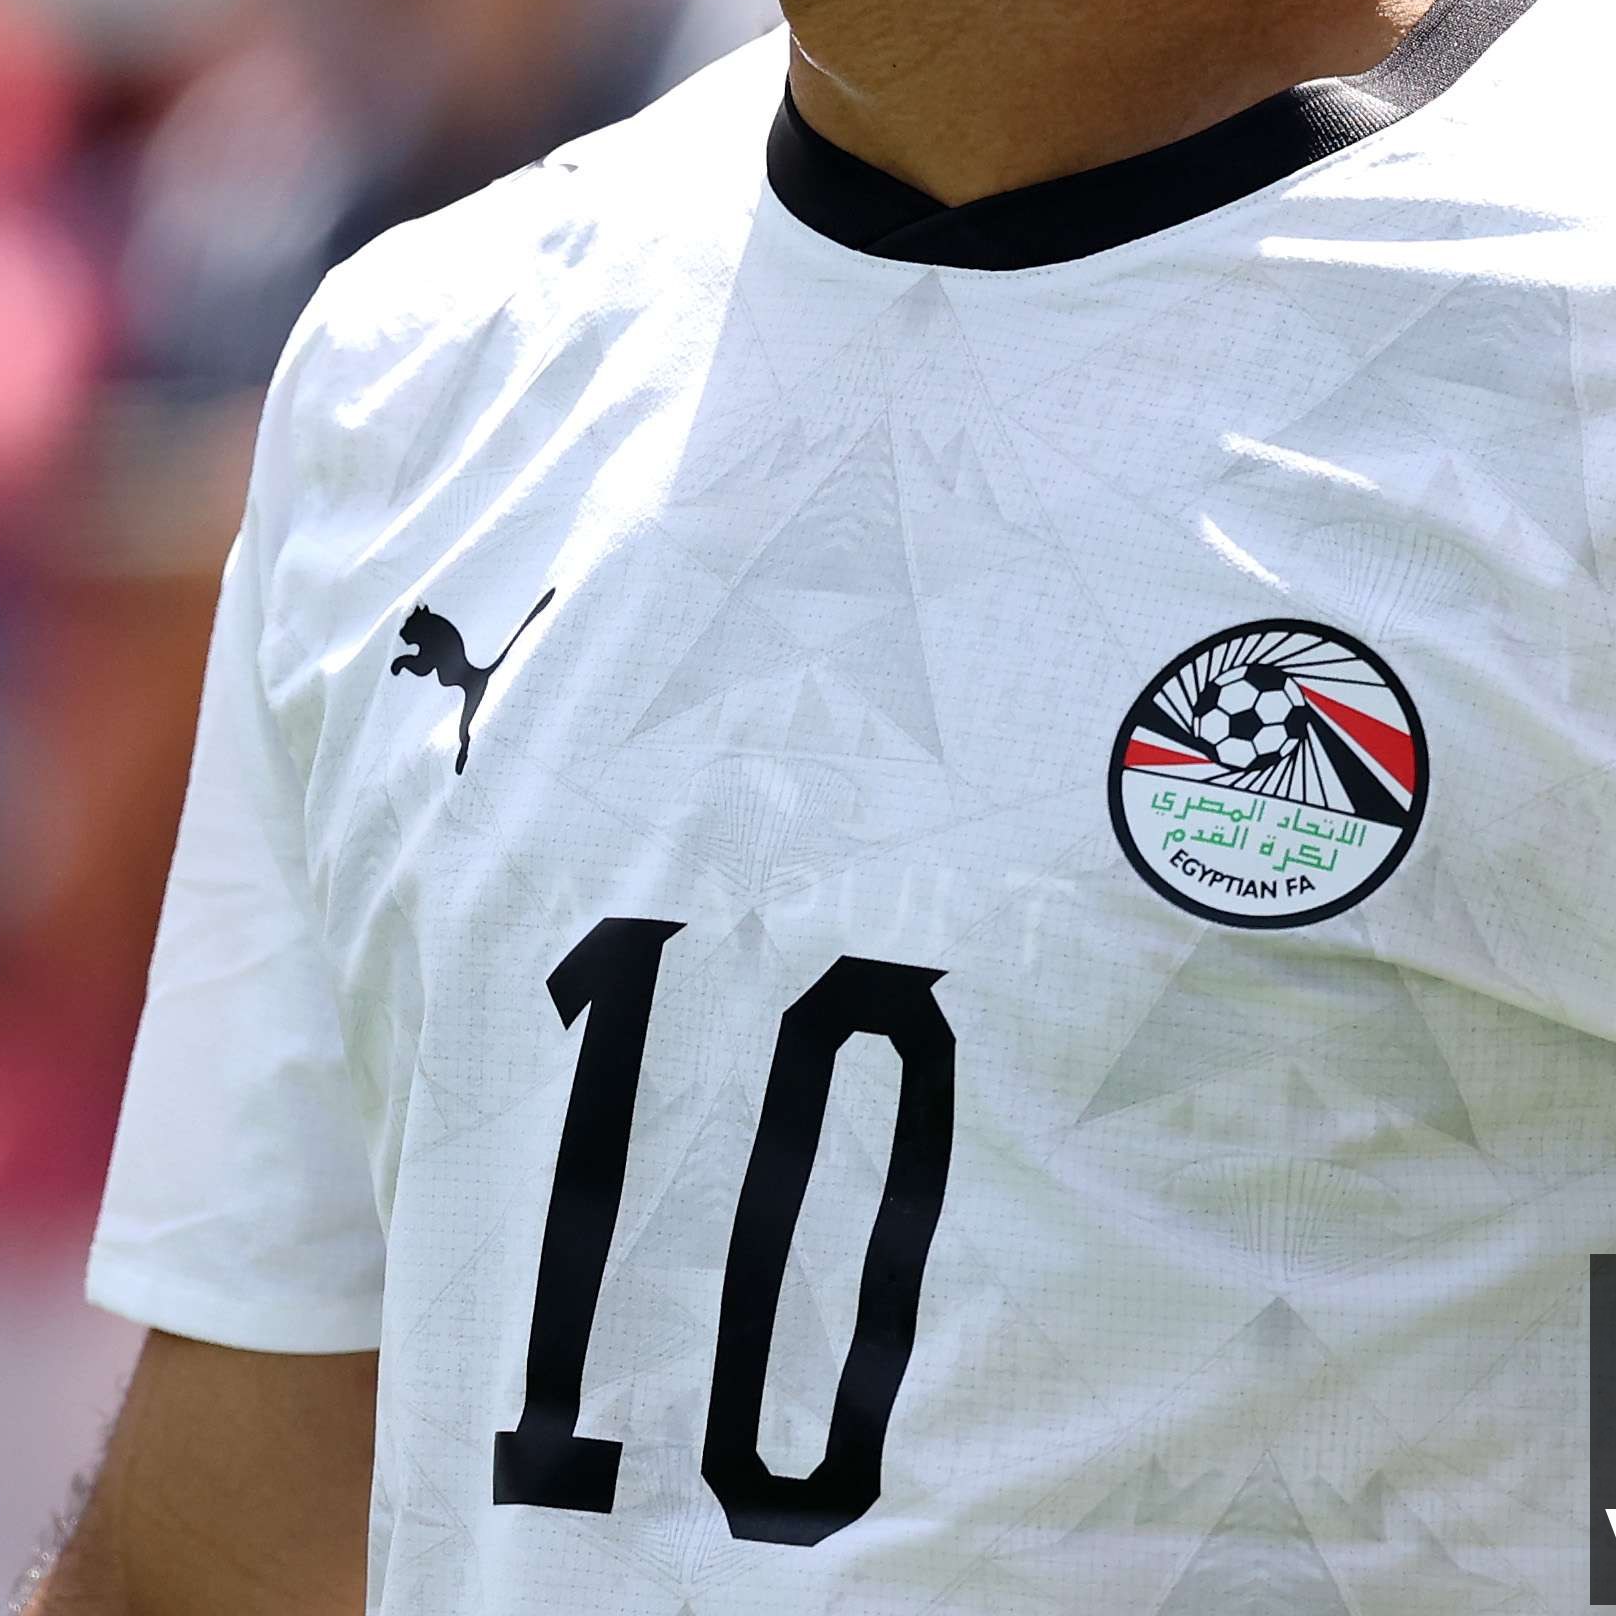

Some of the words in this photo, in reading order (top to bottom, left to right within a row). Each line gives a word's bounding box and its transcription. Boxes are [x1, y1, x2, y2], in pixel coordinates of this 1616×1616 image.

[1162, 825, 1249, 850] القدم
[1277, 808, 1367, 847] الاتحاد
[1169, 849, 1277, 900] EGYPTIAN
[1286, 874, 1316, 897] FA
[493, 917, 957, 1547] 10
